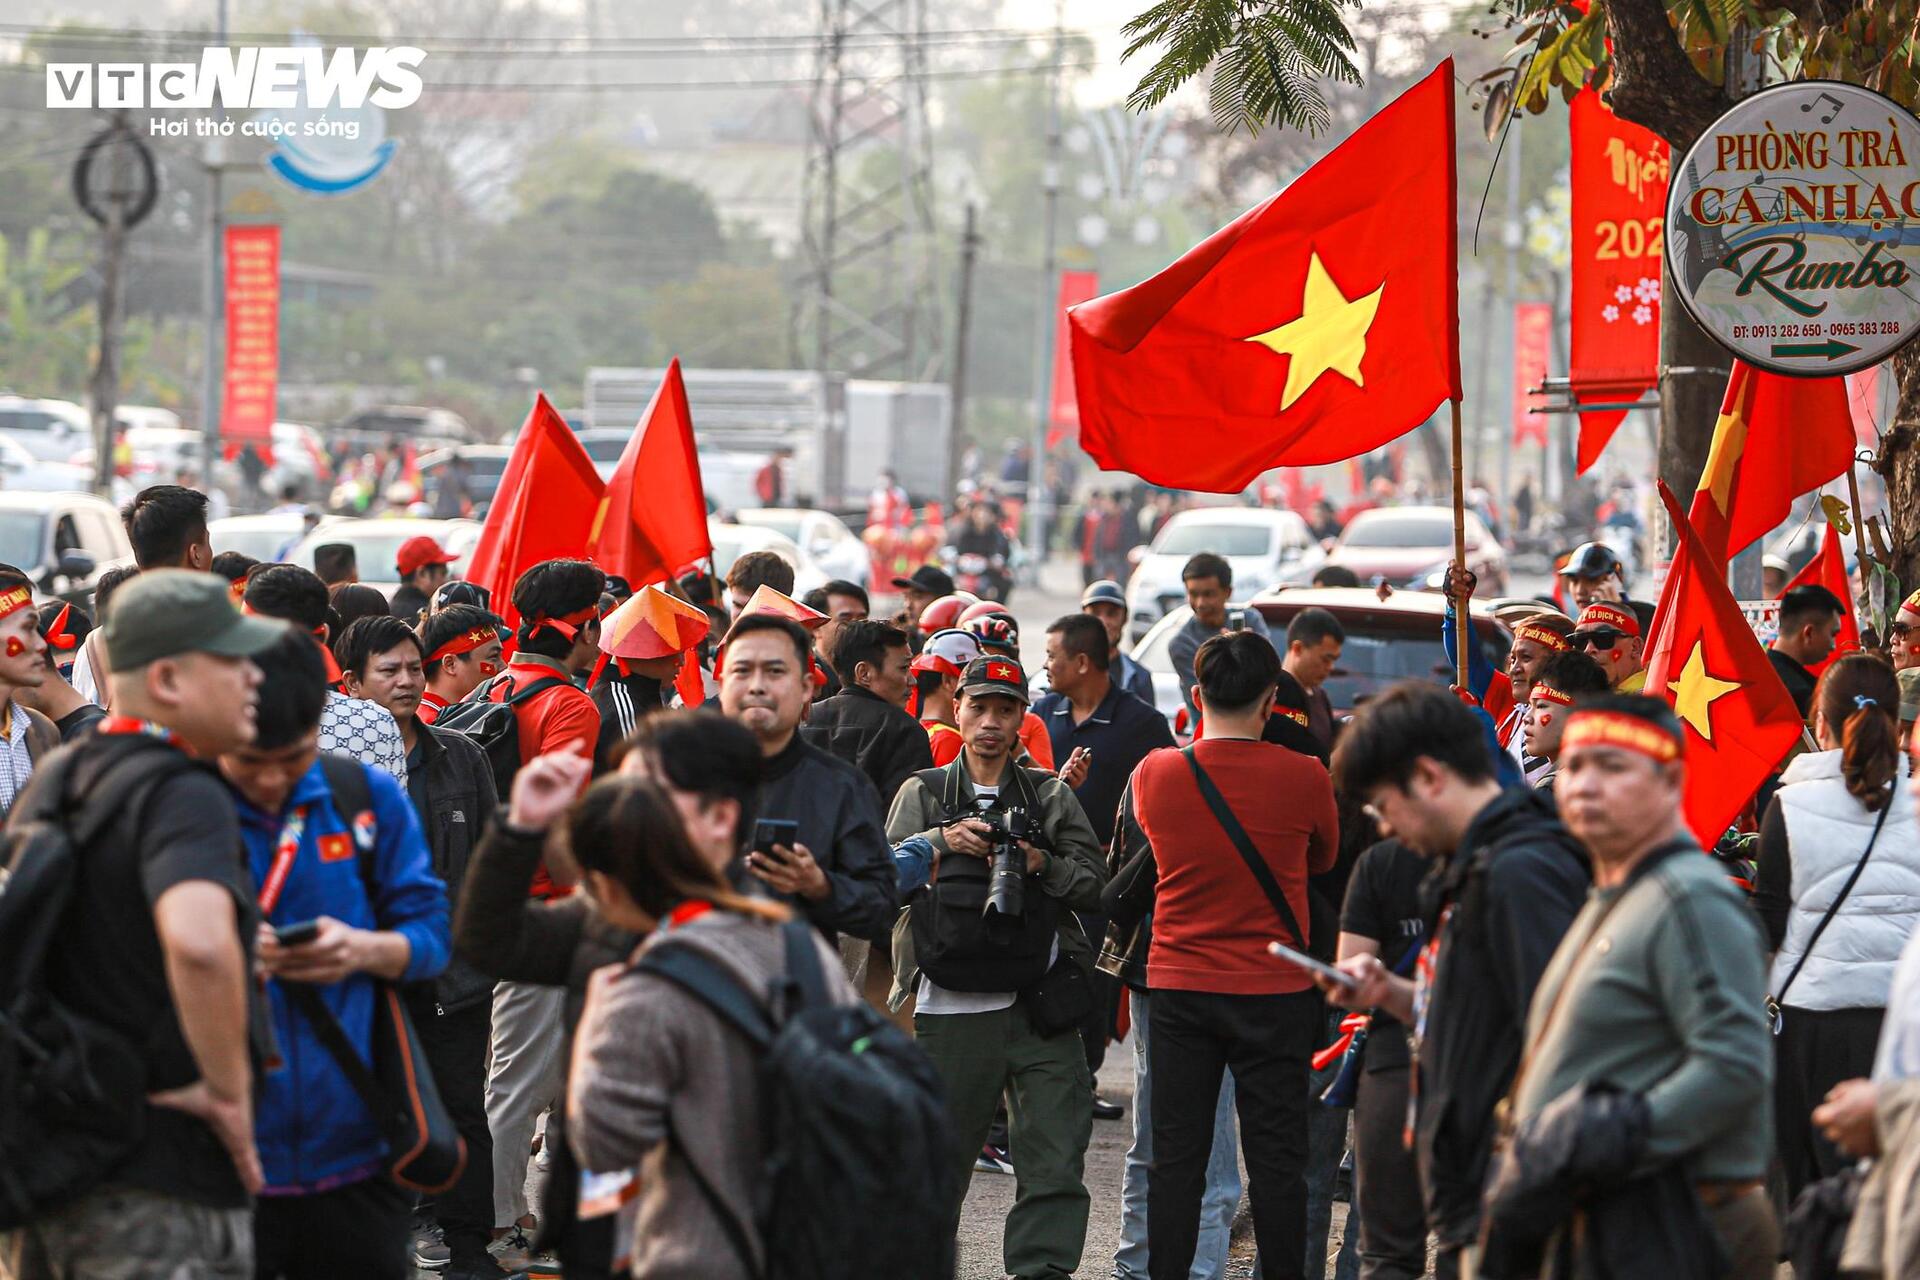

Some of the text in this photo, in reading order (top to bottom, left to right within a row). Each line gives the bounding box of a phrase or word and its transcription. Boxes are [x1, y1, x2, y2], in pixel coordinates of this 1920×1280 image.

[1715, 117, 1909, 172] PHÒNG TRÀ
[1690, 186, 1767, 227] CA
[1595, 217, 1665, 260] 202
[1721, 236, 1911, 318] Rumba
[1733, 325, 1749, 338] ĐT:
[1752, 324, 1777, 338] 0913
[1780, 324, 1799, 337] 282
[1802, 323, 1821, 336] 650
[1830, 322, 1856, 336] 0965
[1858, 321, 1878, 335] 383
[1880, 321, 1900, 334] 288
